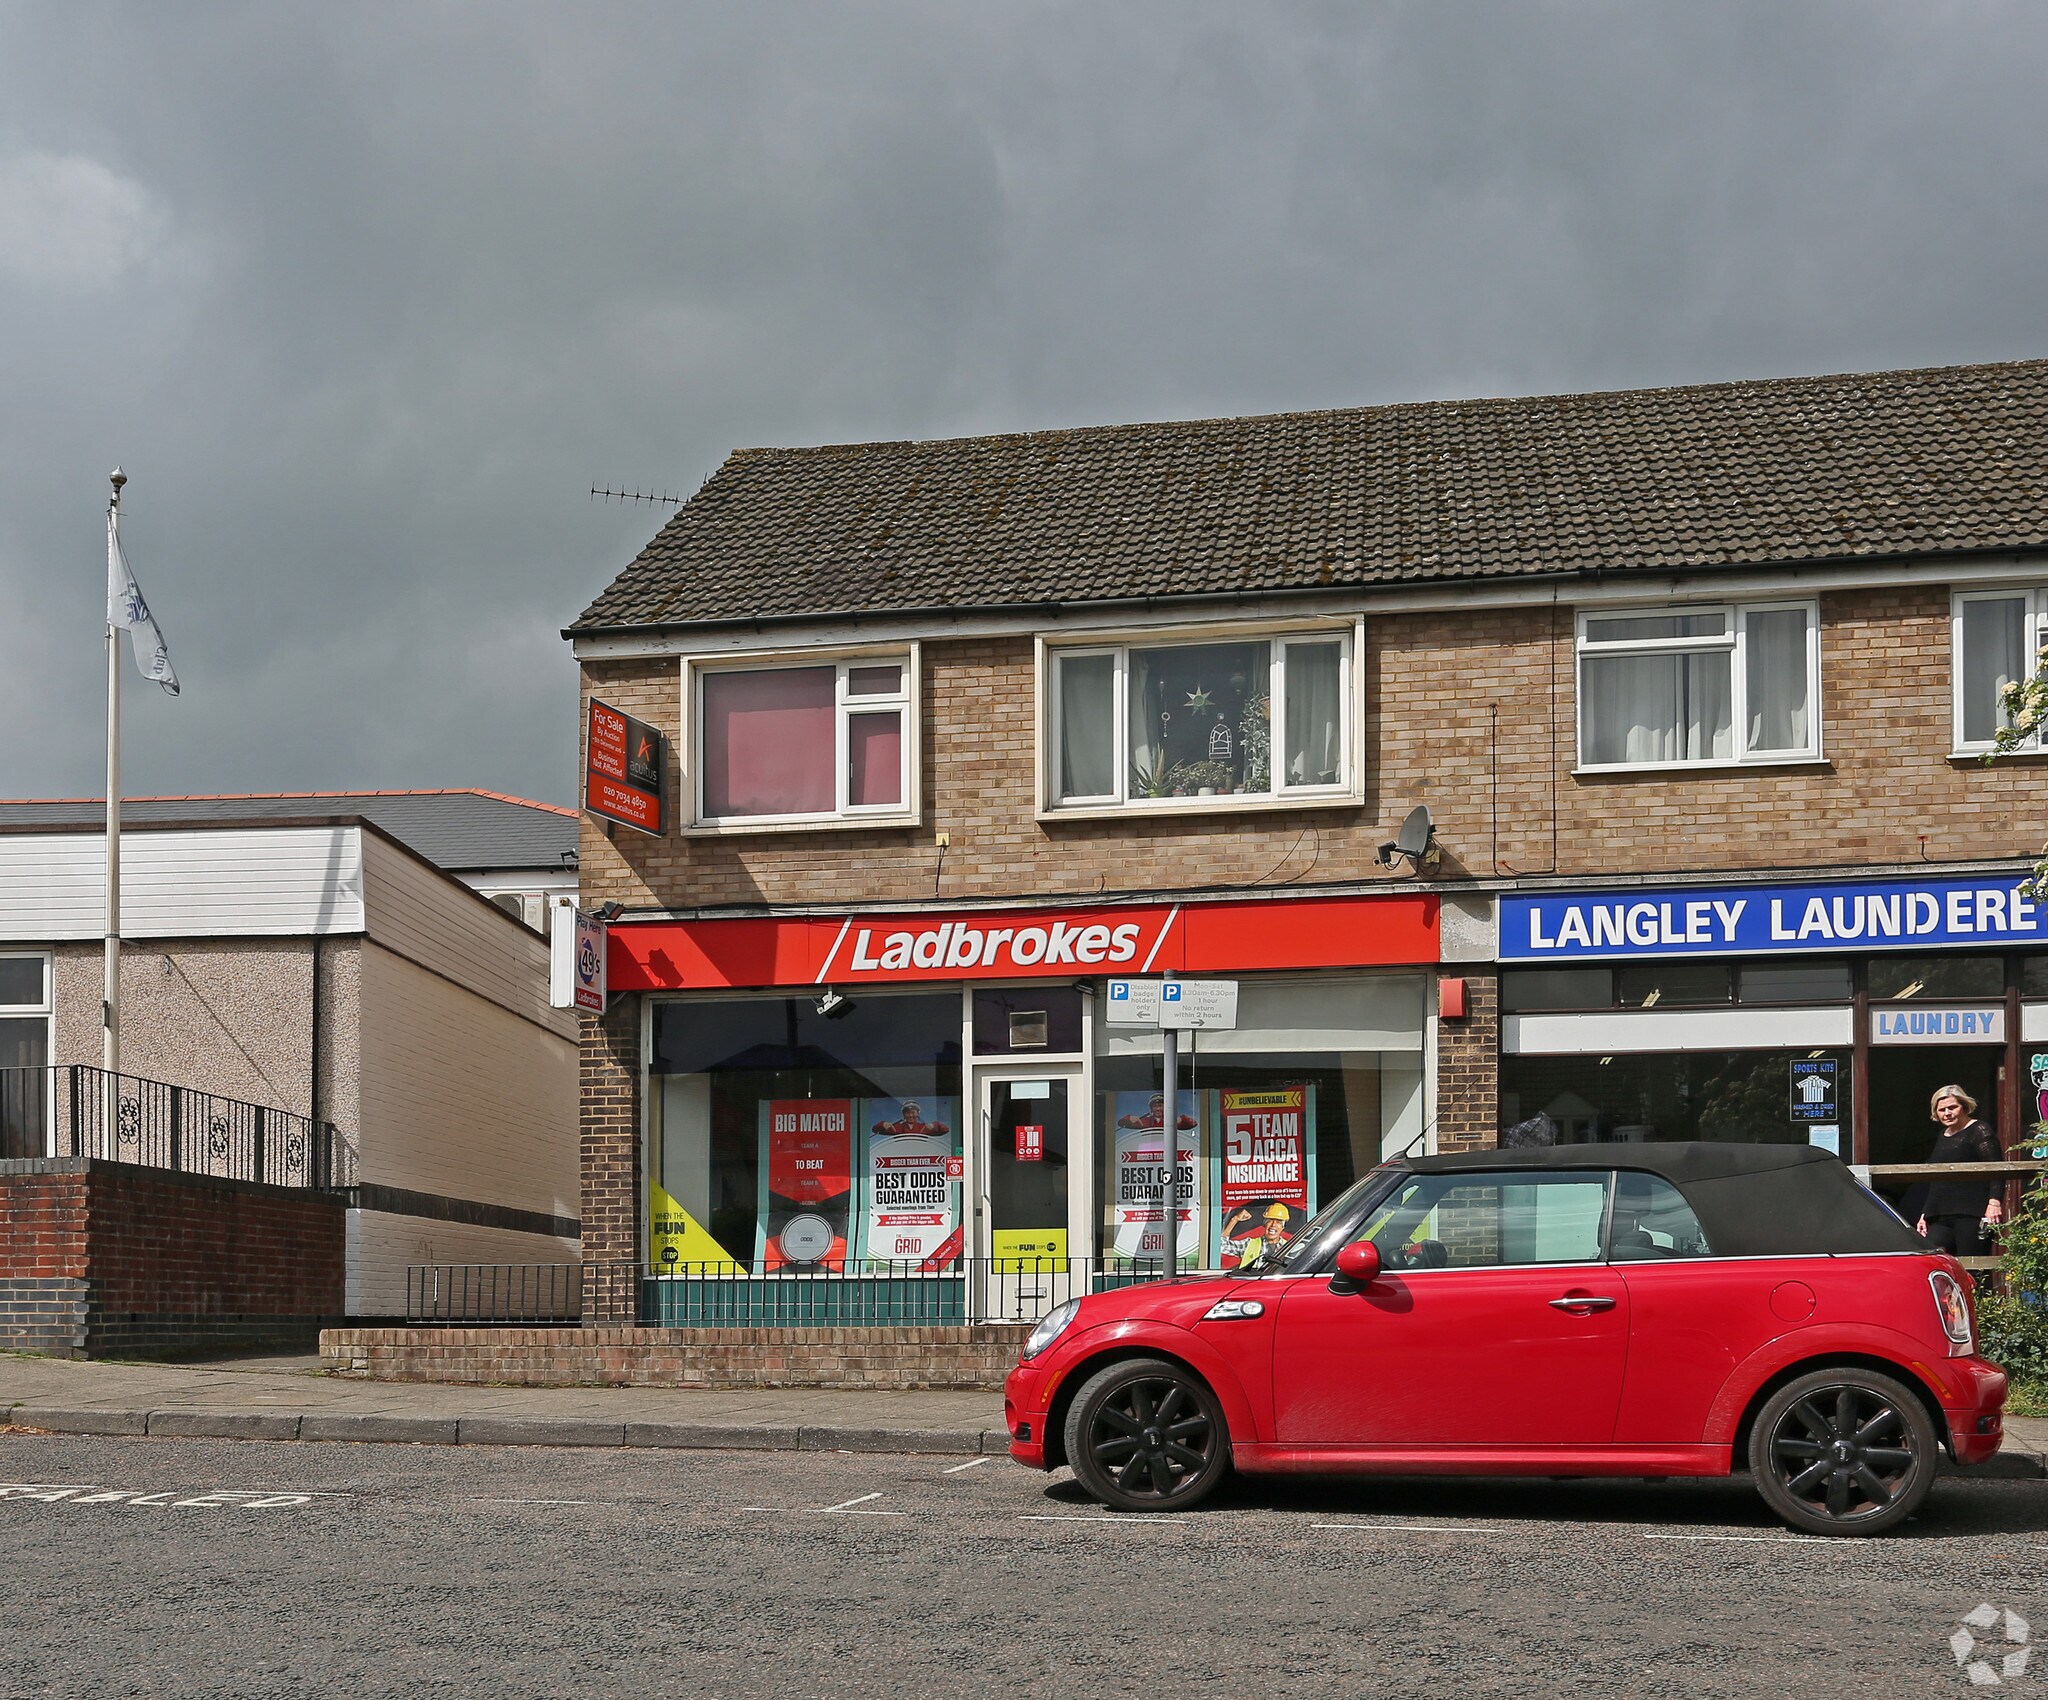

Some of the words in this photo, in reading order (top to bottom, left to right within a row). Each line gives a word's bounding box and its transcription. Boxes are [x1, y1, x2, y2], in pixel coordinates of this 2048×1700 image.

[594, 709, 606, 725] For
[607, 715, 623, 734] Sale
[604, 729, 621, 742] Auction
[597, 751, 619, 766] Business
[592, 758, 603, 769] Not
[603, 762, 623, 777] Affected
[629, 760, 658, 780] acuitus
[603, 786, 616, 797] 020
[616, 790, 631, 805] 7034
[631, 795, 647, 810] 4850
[1529, 899, 1748, 949] LANGLEY
[850, 920, 1141, 971] Ladbrokes
[582, 950, 601, 974] 49's
[1879, 1012, 1995, 1036] LAUNDRY
[1793, 1063, 1817, 1073] SPORTS
[1820, 1063, 1835, 1073] KITS
[1238, 1095, 1287, 1105] #UNBELIEVABLE
[775, 1113, 797, 1132] BIG
[800, 1112, 845, 1132] MATCH
[1803, 1110, 1825, 1118] HERE
[1226, 1114, 1252, 1164] 5
[1252, 1112, 1298, 1137] TEAM
[1252, 1138, 1298, 1163] ACCA
[795, 1160, 804, 1170] TO
[806, 1160, 824, 1170] BEAT
[890, 1158, 906, 1166] BIGGER
[876, 1172, 907, 1189] BEST
[910, 1171, 945, 1188] ODDS
[1121, 1167, 1153, 1184] BEST
[1158, 1166, 1193, 1184] ODS
[1227, 1163, 1299, 1184] INSURANCE
[876, 1189, 945, 1204] GUARANTEED
[655, 1212, 672, 1220] WHEN
[654, 1221, 685, 1235] FUN
[660, 1236, 679, 1244] STOPS
[895, 1238, 922, 1254] GRID
[1142, 1234, 1164, 1250] GRI
[662, 1251, 678, 1259] STOP
